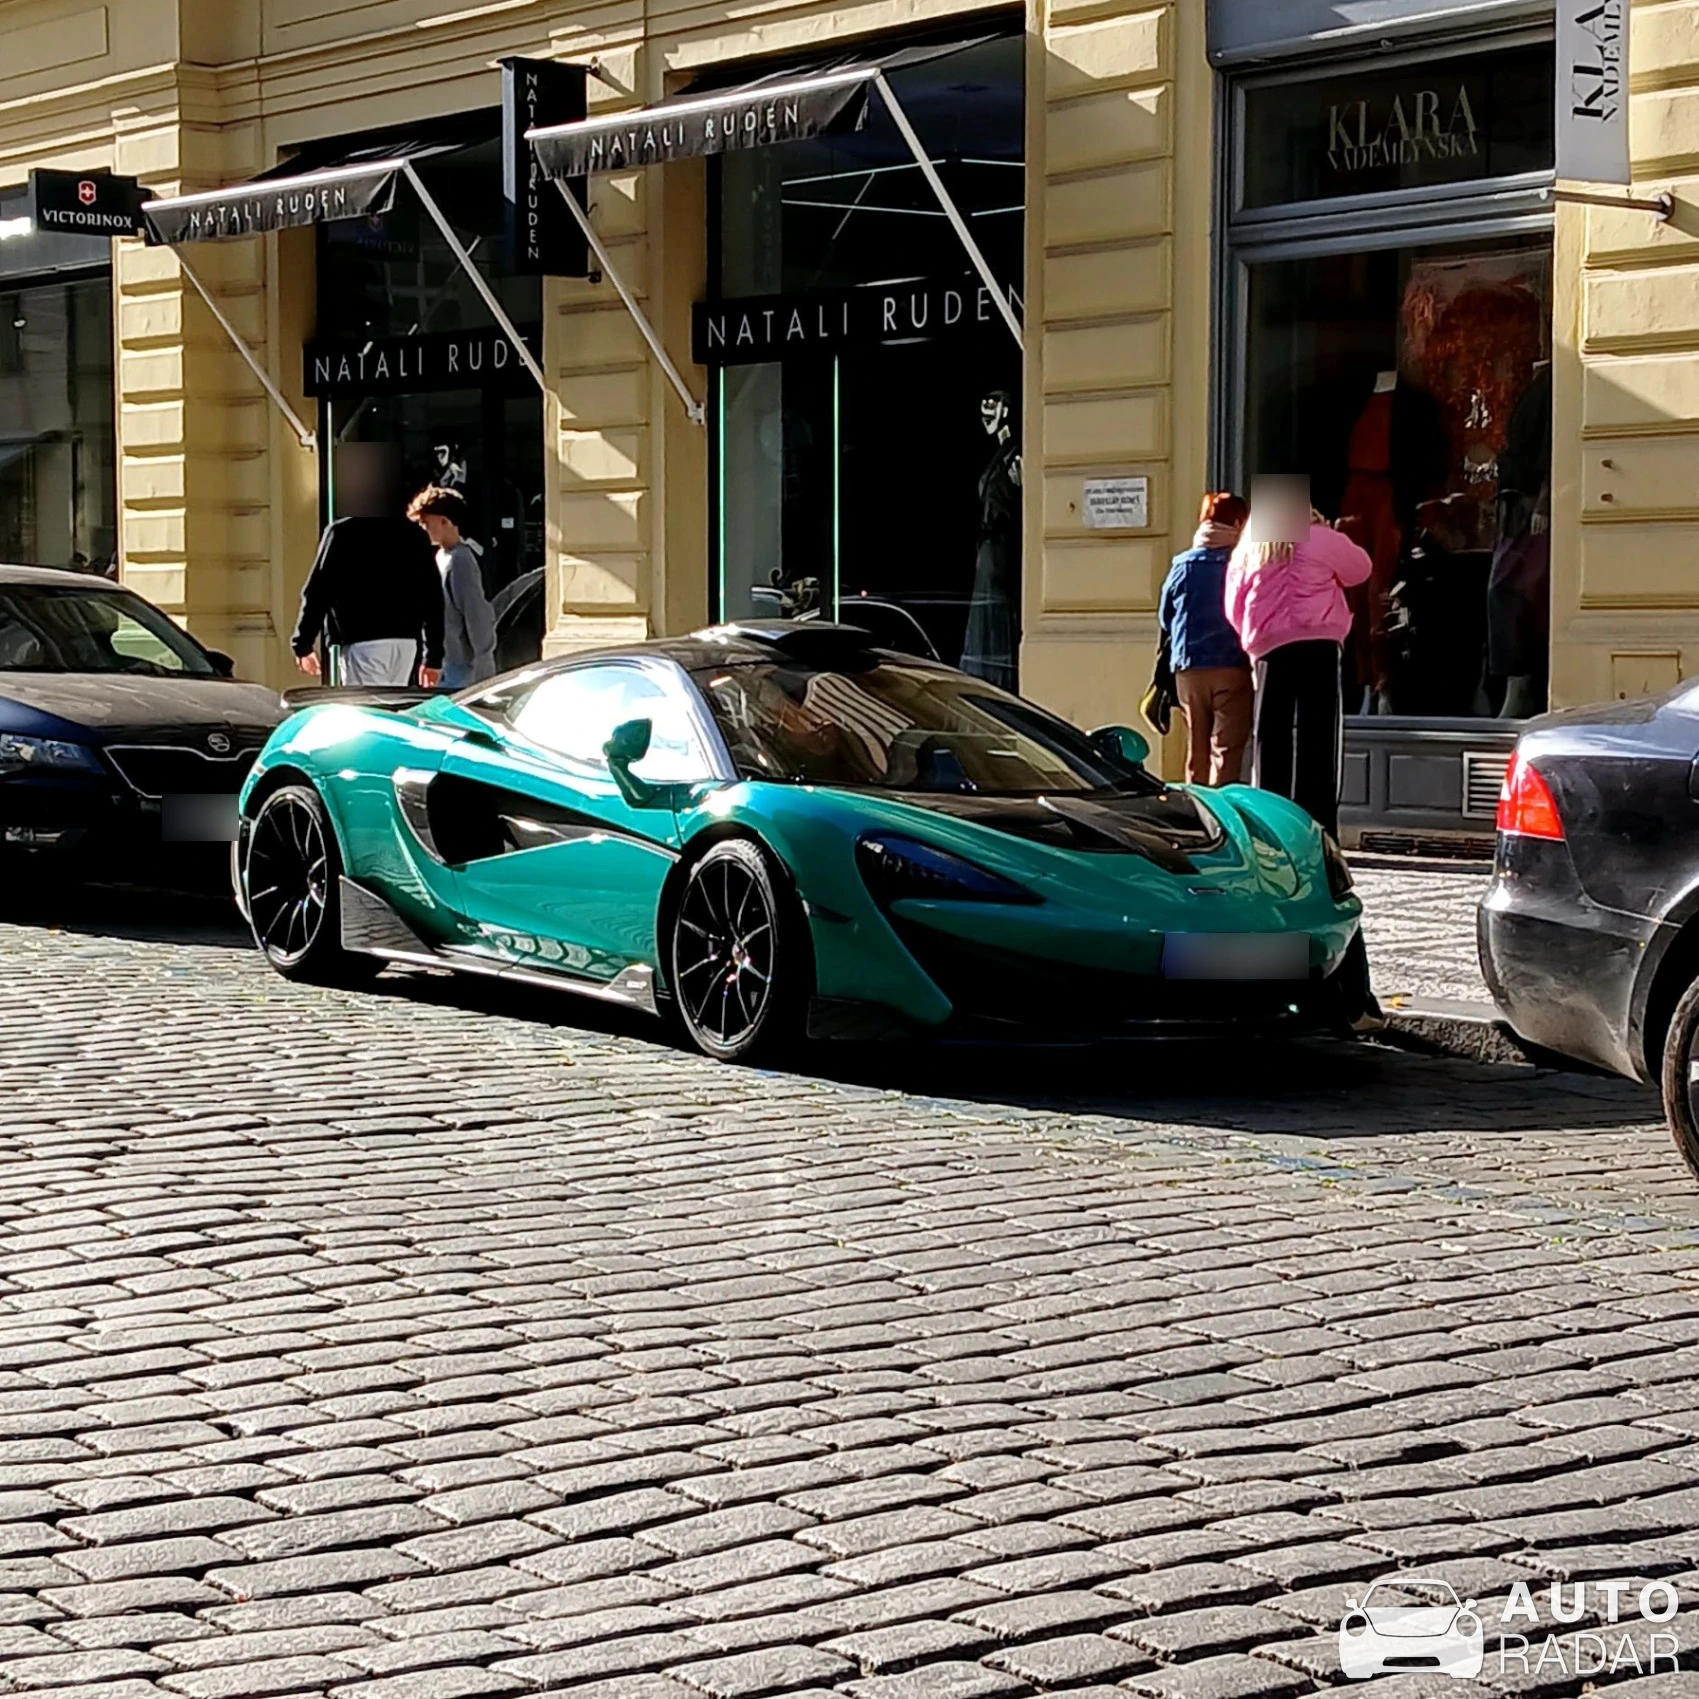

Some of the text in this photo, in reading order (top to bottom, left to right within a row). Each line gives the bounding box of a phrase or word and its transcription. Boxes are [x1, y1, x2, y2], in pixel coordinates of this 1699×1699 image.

[590, 104, 798, 157] NATALI RUDEN
[1329, 84, 1480, 151] KLARA
[42, 208, 132, 229] VICTORINOX
[190, 187, 346, 228] NATALI RUDEN
[707, 301, 848, 348] NATALI
[315, 347, 422, 384] NATALI
